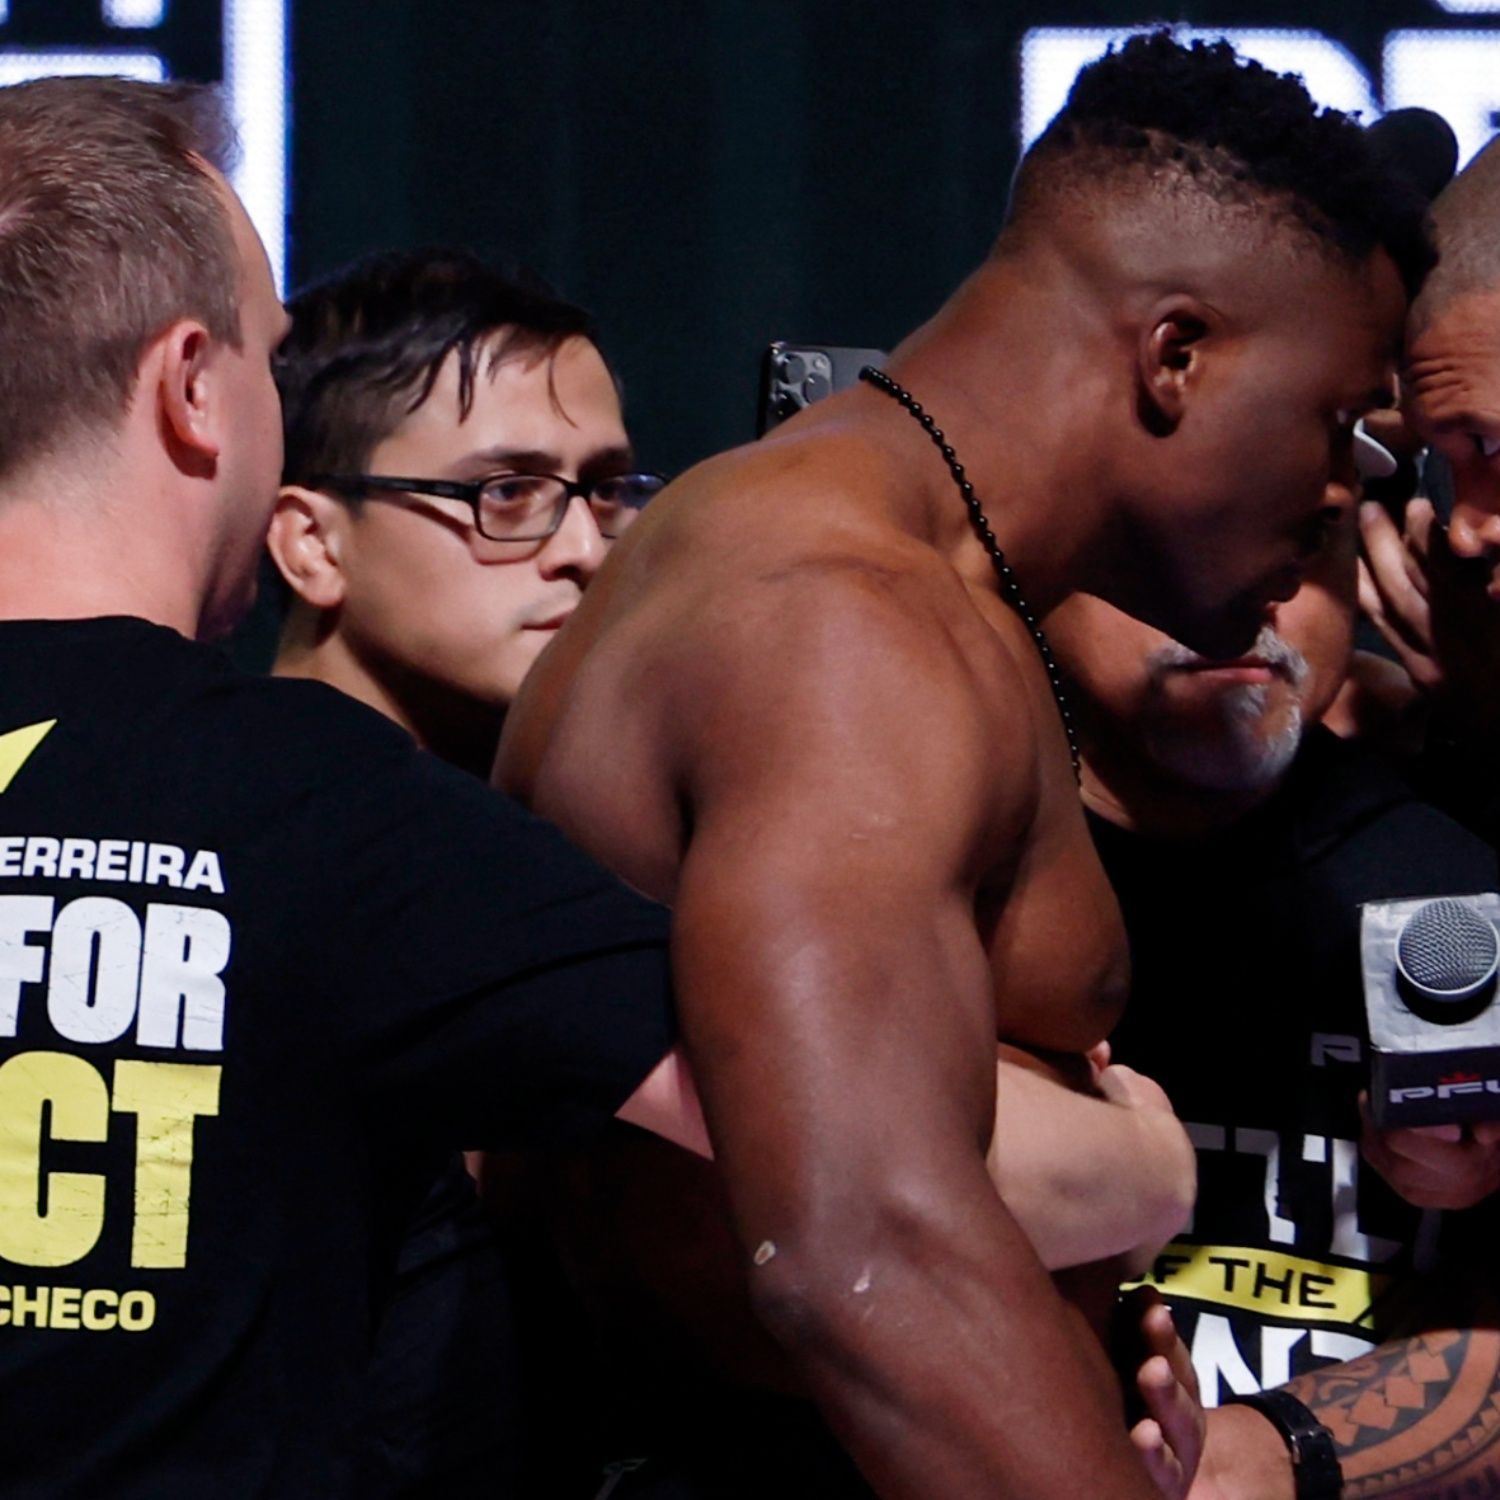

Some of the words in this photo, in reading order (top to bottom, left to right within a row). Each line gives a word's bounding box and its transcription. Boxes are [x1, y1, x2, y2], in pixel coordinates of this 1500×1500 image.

[0, 837, 225, 893] ERREIRA
[0, 895, 231, 1051] FOR
[0, 1051, 222, 1269] CT
[1131, 1256, 1191, 1283] F
[1208, 1256, 1336, 1310] THE
